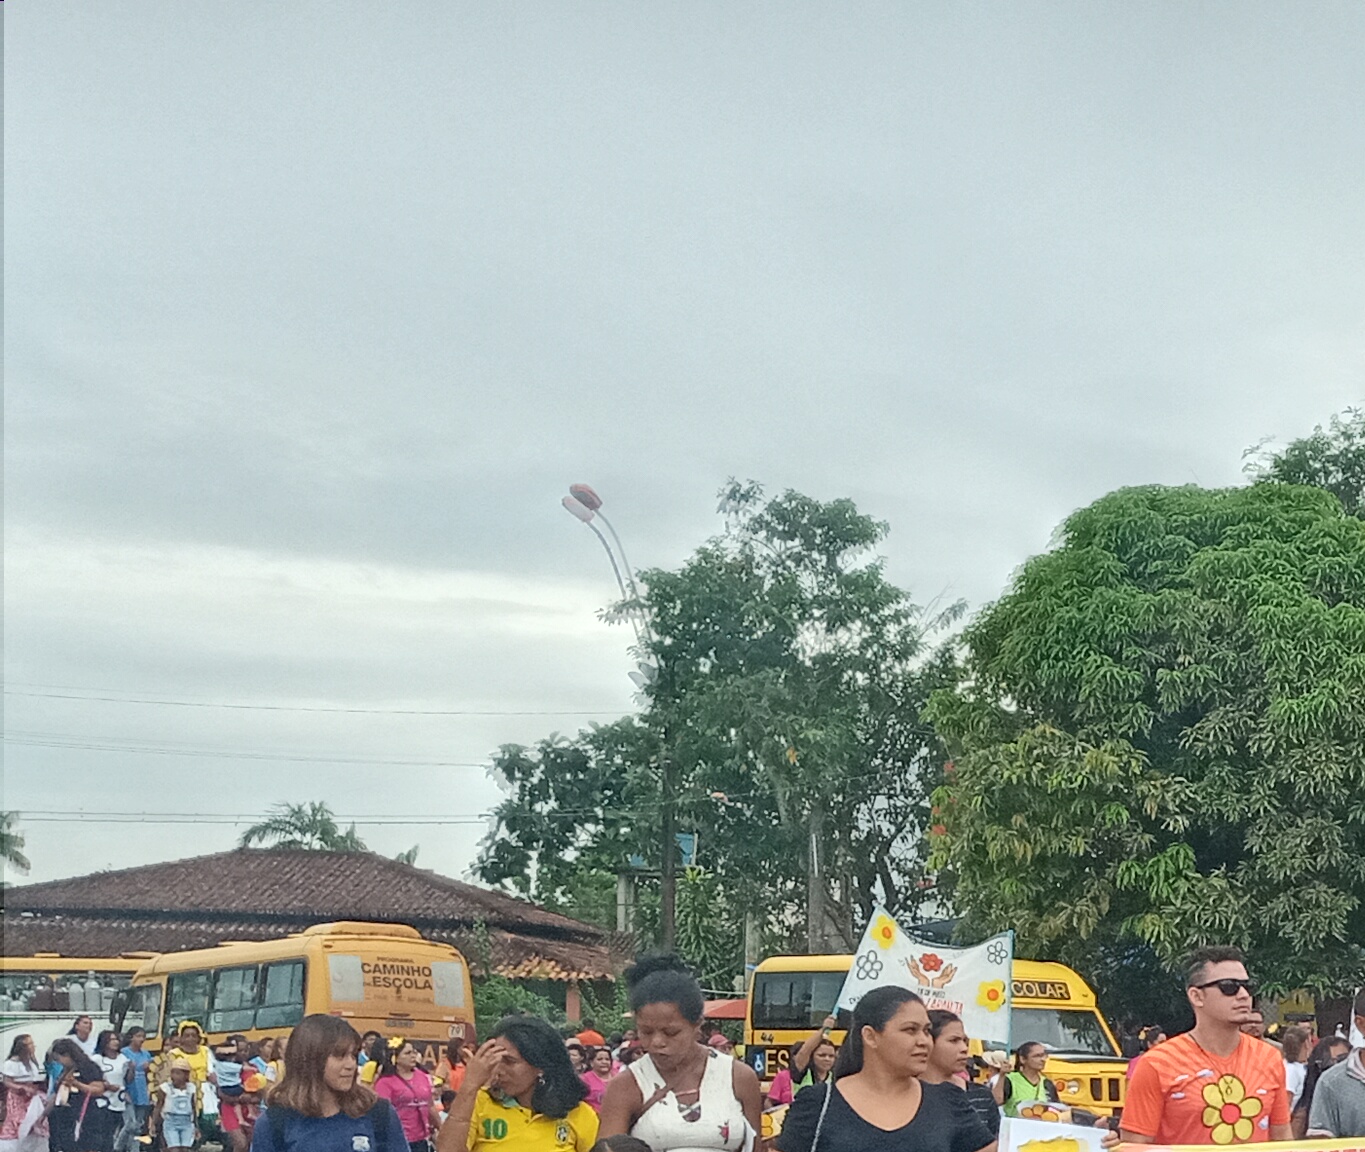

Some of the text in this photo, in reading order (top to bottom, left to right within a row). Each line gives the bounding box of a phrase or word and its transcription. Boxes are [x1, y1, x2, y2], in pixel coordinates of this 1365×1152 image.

[361, 962, 432, 978] CAMINHO
[372, 976, 433, 991] ESCOLA
[1011, 981, 1069, 999] COLAR
[765, 1048, 790, 1077] ES
[481, 1118, 509, 1140] 10
